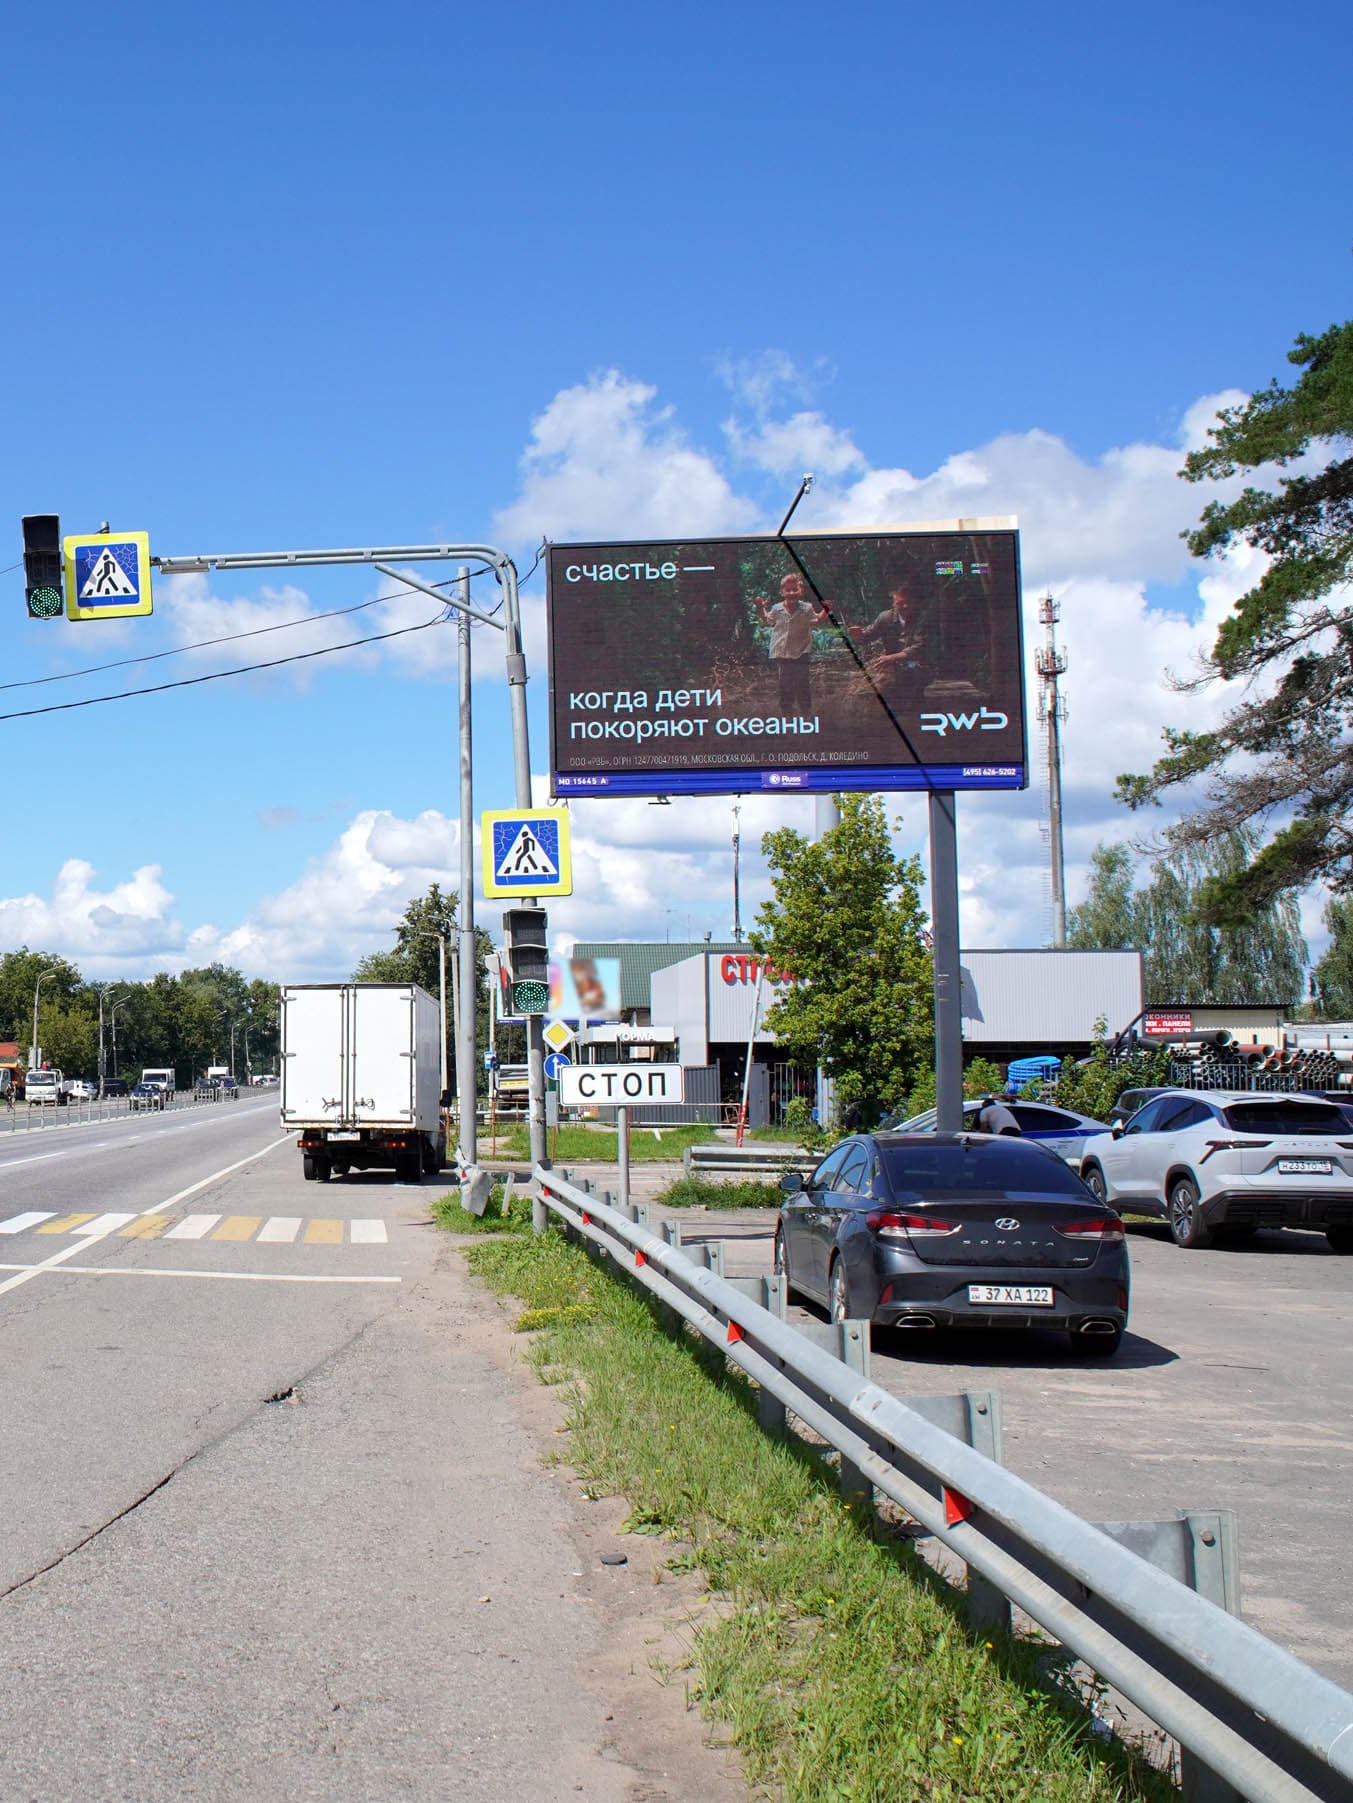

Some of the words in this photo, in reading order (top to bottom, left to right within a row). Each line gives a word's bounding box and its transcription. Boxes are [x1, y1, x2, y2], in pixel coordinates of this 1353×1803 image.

[565, 561, 677, 582] счастье
[569, 690, 648, 713] когда
[655, 688, 723, 713] дети
[570, 718, 709, 744] покоряют
[715, 715, 820, 736] океаны
[569, 757, 586, 767] ООО
[613, 755, 632, 766] ОГРН
[691, 753, 739, 764] МОСКОВСКАЯ
[829, 751, 869, 762] КОЛЕДИНО
[781, 775, 801, 783] Russ
[578, 1072, 666, 1098] СТОП
[985, 1287, 1000, 1300] 37
[1004, 1288, 1022, 1301] XA
[1025, 1289, 1049, 1302] 122
